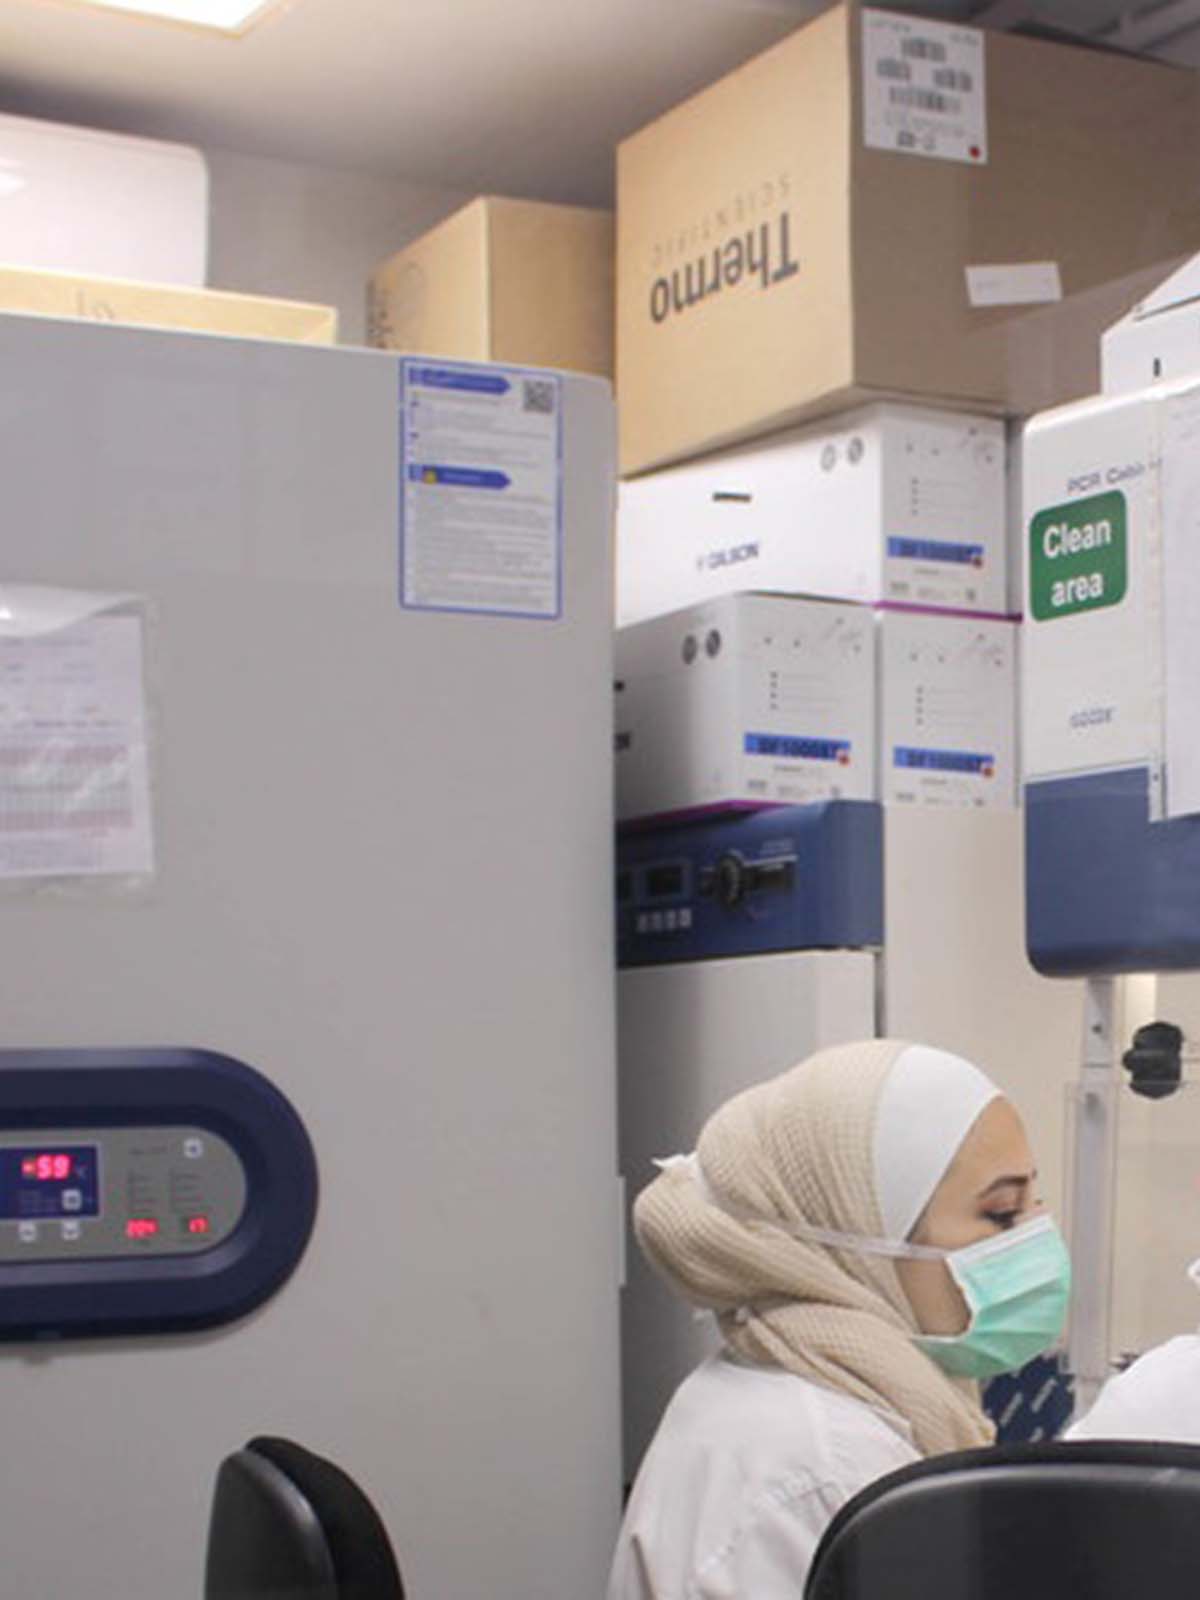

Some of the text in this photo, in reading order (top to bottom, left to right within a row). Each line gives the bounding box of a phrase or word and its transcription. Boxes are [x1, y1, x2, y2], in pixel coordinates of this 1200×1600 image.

[651, 212, 799, 324] Thermo
[1042, 519, 1111, 559] Clean
[1051, 572, 1103, 607] area
